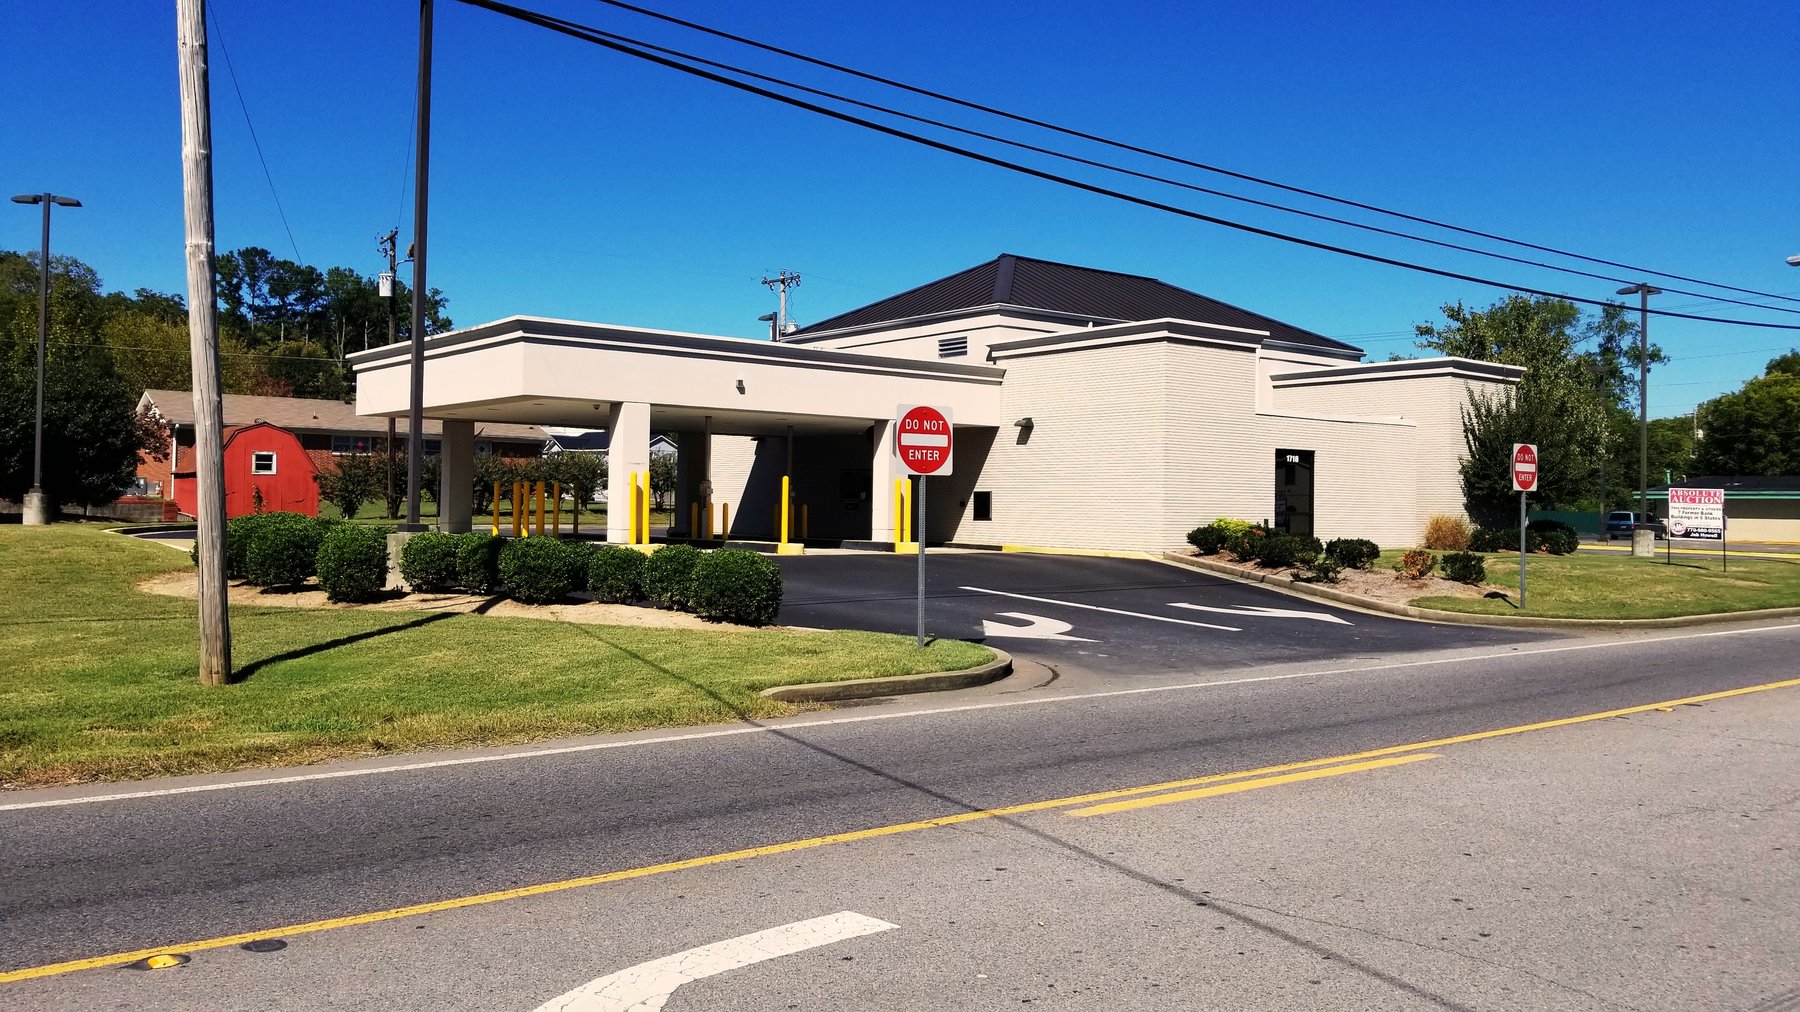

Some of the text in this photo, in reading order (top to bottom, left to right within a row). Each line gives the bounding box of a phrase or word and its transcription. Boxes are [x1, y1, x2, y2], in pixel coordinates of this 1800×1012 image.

[905, 419, 944, 431] DO NOT
[908, 449, 940, 461] ENTER
[1286, 455, 1299, 463] 1718
[1517, 453, 1534, 462] DO NOT
[1518, 473, 1533, 482] ENTER
[1671, 496, 1721, 504] AUCTION
